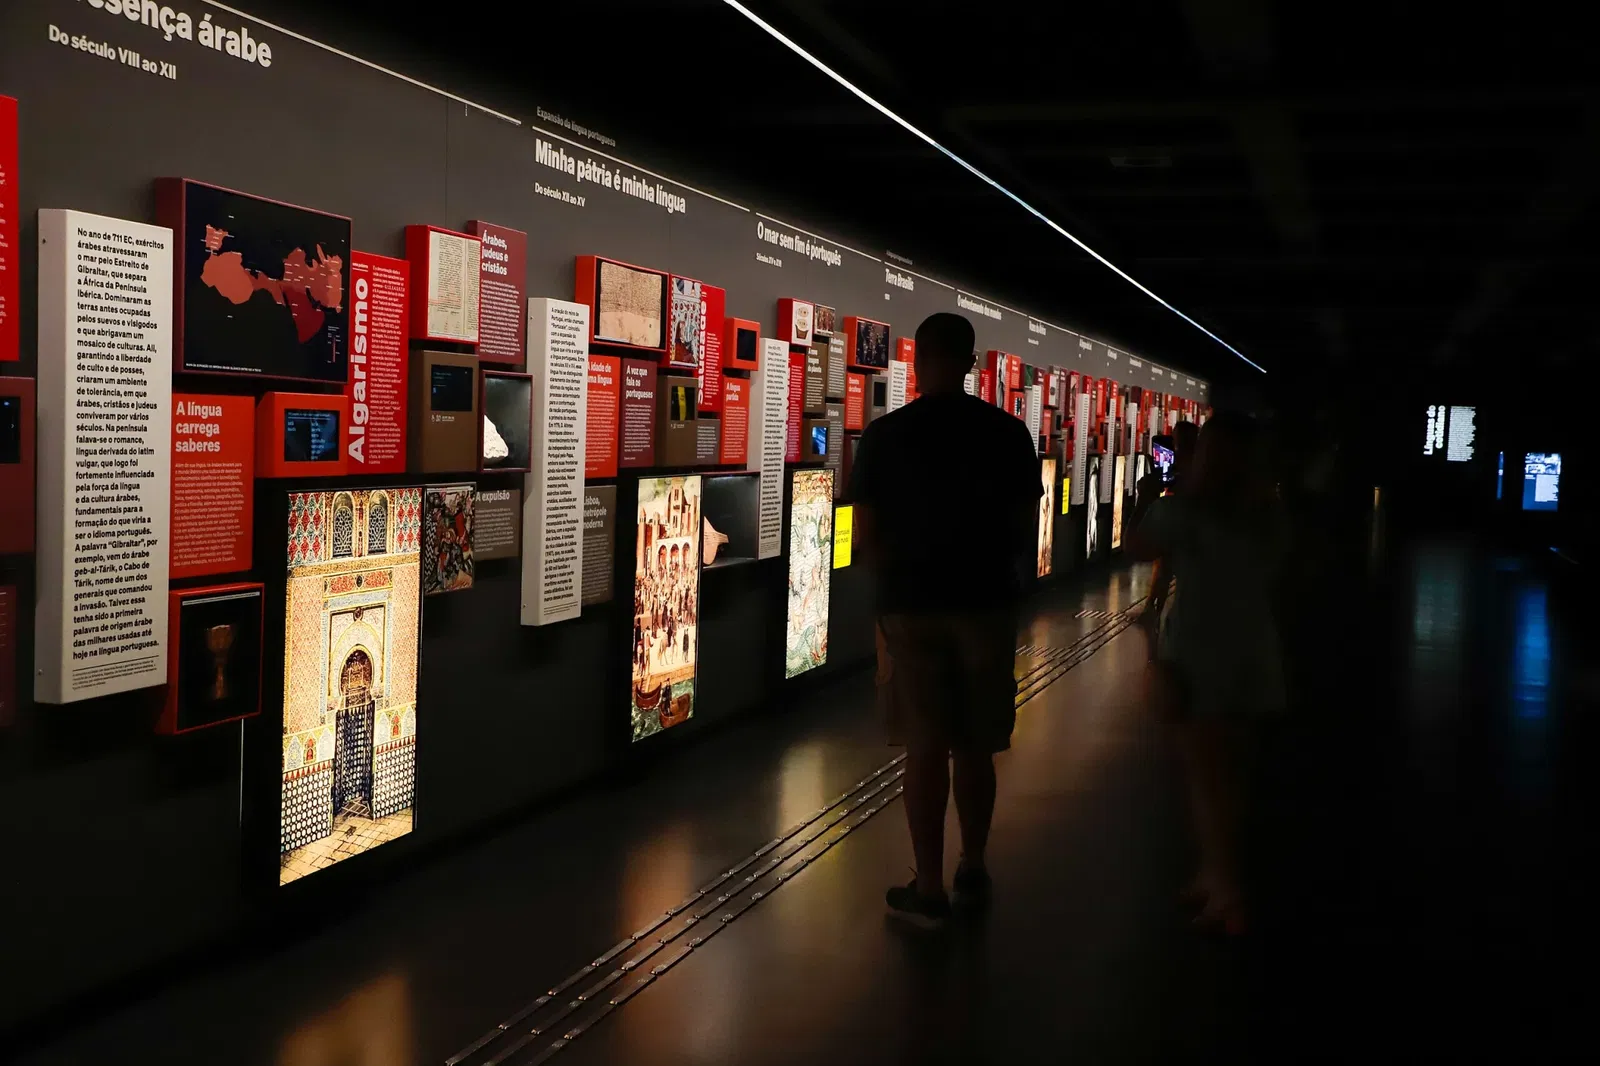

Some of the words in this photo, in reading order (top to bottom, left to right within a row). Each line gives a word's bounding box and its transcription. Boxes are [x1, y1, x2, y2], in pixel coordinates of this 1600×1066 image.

[77, 0, 192, 42] sença
[198, 14, 272, 68] árabe
[49, 24, 69, 45] Do
[71, 35, 116, 60] século
[118, 47, 140, 68] VIII
[142, 59, 157, 73] ao
[160, 61, 176, 80] XII
[537, 106, 563, 126] Expansão
[564, 118, 571, 129] da
[571, 121, 587, 135] língua
[588, 130, 616, 147] portuguesa
[536, 138, 575, 175] Minha
[577, 158, 612, 188] pátria
[614, 169, 621, 191] é
[622, 175, 654, 203] minha
[656, 184, 686, 214] língua
[535, 182, 543, 194] Do
[544, 186, 561, 200] século
[570, 196, 577, 205] ao
[577, 196, 585, 207] XV
[78, 228, 87, 236] No
[103, 232, 111, 240] de
[112, 233, 122, 242] 711
[124, 235, 134, 245] EC,
[136, 239, 164, 249] exércitos
[482, 230, 507, 250] Árabes,
[757, 221, 764, 239] O
[764, 227, 779, 245] mar
[780, 234, 794, 250] sem
[795, 235, 805, 254] fim
[806, 240, 810, 256] é
[810, 244, 841, 266] português
[78, 240, 101, 251] árabes
[103, 245, 147, 258] atravessaram
[482, 246, 503, 261] judeus
[504, 254, 508, 262] e
[98, 257, 113, 265] pelo
[114, 258, 140, 269] Estreito
[482, 262, 507, 275] cristãos
[78, 265, 110, 278] Gibraltar,
[125, 273, 147, 281] separa
[83, 276, 104, 288] África
[105, 281, 114, 289] da
[115, 282, 147, 293] Península
[78, 289, 103, 300] Ibérica.
[105, 292, 143, 304] Dominaram
[77, 302, 98, 311] terras
[119, 308, 150, 317] ocupadas
[77, 314, 96, 323] pelos
[127, 319, 157, 329] visigodos
[97, 328, 132, 338] abrigavam
[77, 340, 106, 348] mosaico
[117, 342, 145, 351] culturas.
[77, 352, 114, 360] garantindo
[121, 354, 151, 363] liberdade
[77, 363, 86, 371] de
[120, 367, 144, 375] posses,
[348, 278, 369, 464] Algarismo
[176, 401, 185, 416] A
[188, 402, 222, 419] língua
[176, 422, 220, 438] carrega
[175, 438, 220, 452] saberes
[476, 492, 481, 501] A
[482, 490, 510, 503] expulsão
[75, 554, 105, 563] exemplo,
[131, 550, 150, 558] árabe
[124, 562, 140, 570] Cabo
[74, 578, 94, 587] Tárik,
[74, 589, 104, 601] generais
[105, 589, 117, 597] que
[119, 584, 152, 594] comandou
[80, 601, 108, 611] invasão.
[108, 598, 130, 607] Talvez
[74, 614, 93, 623] tenha
[95, 612, 109, 620] sido
[115, 608, 143, 619] primeira
[73, 626, 99, 637] palavra
[110, 621, 133, 630] origem
[134, 618, 152, 626] árabe
[87, 635, 116, 645] milhares
[117, 631, 140, 640] usadas
[142, 628, 152, 636] até
[73, 650, 88, 660] hoje
[99, 646, 119, 655] língua
[120, 640, 159, 653] portuguesa.
